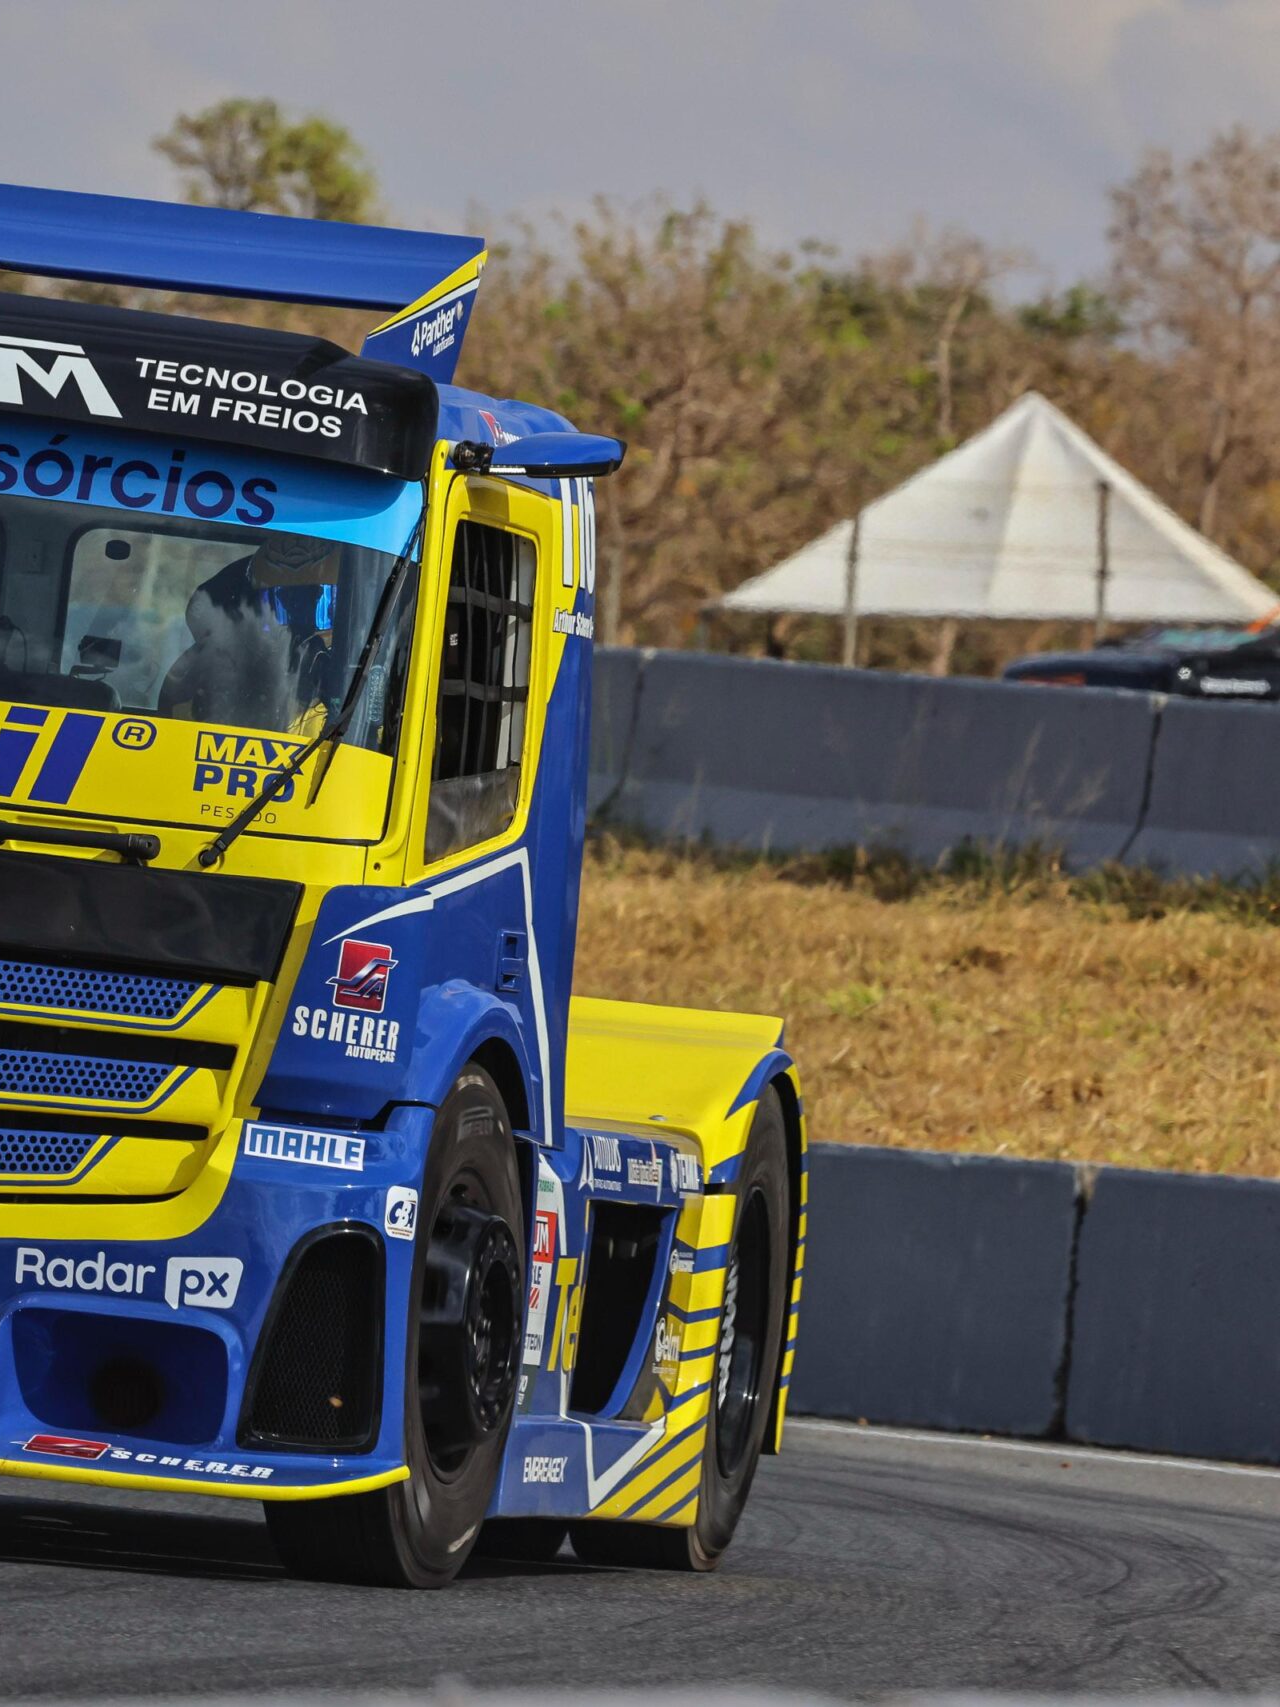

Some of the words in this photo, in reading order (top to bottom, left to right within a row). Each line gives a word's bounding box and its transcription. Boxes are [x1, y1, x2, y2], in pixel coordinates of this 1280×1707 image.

[420, 307, 456, 350] Panther
[135, 357, 369, 415] TECNOLOGIA
[147, 388, 201, 415] EM
[210, 397, 342, 438] FREIOS
[198, 733, 300, 769] MAX
[200, 804, 277, 824] PESDO
[292, 1005, 400, 1051] SCHERER
[345, 1045, 396, 1063] AUTOPEÇAS
[247, 1126, 363, 1167] MAHLE
[389, 1200, 417, 1228] CBA
[15, 1247, 156, 1294] Radar
[178, 1268, 230, 1309] px
[110, 1450, 274, 1479] SCHERER
